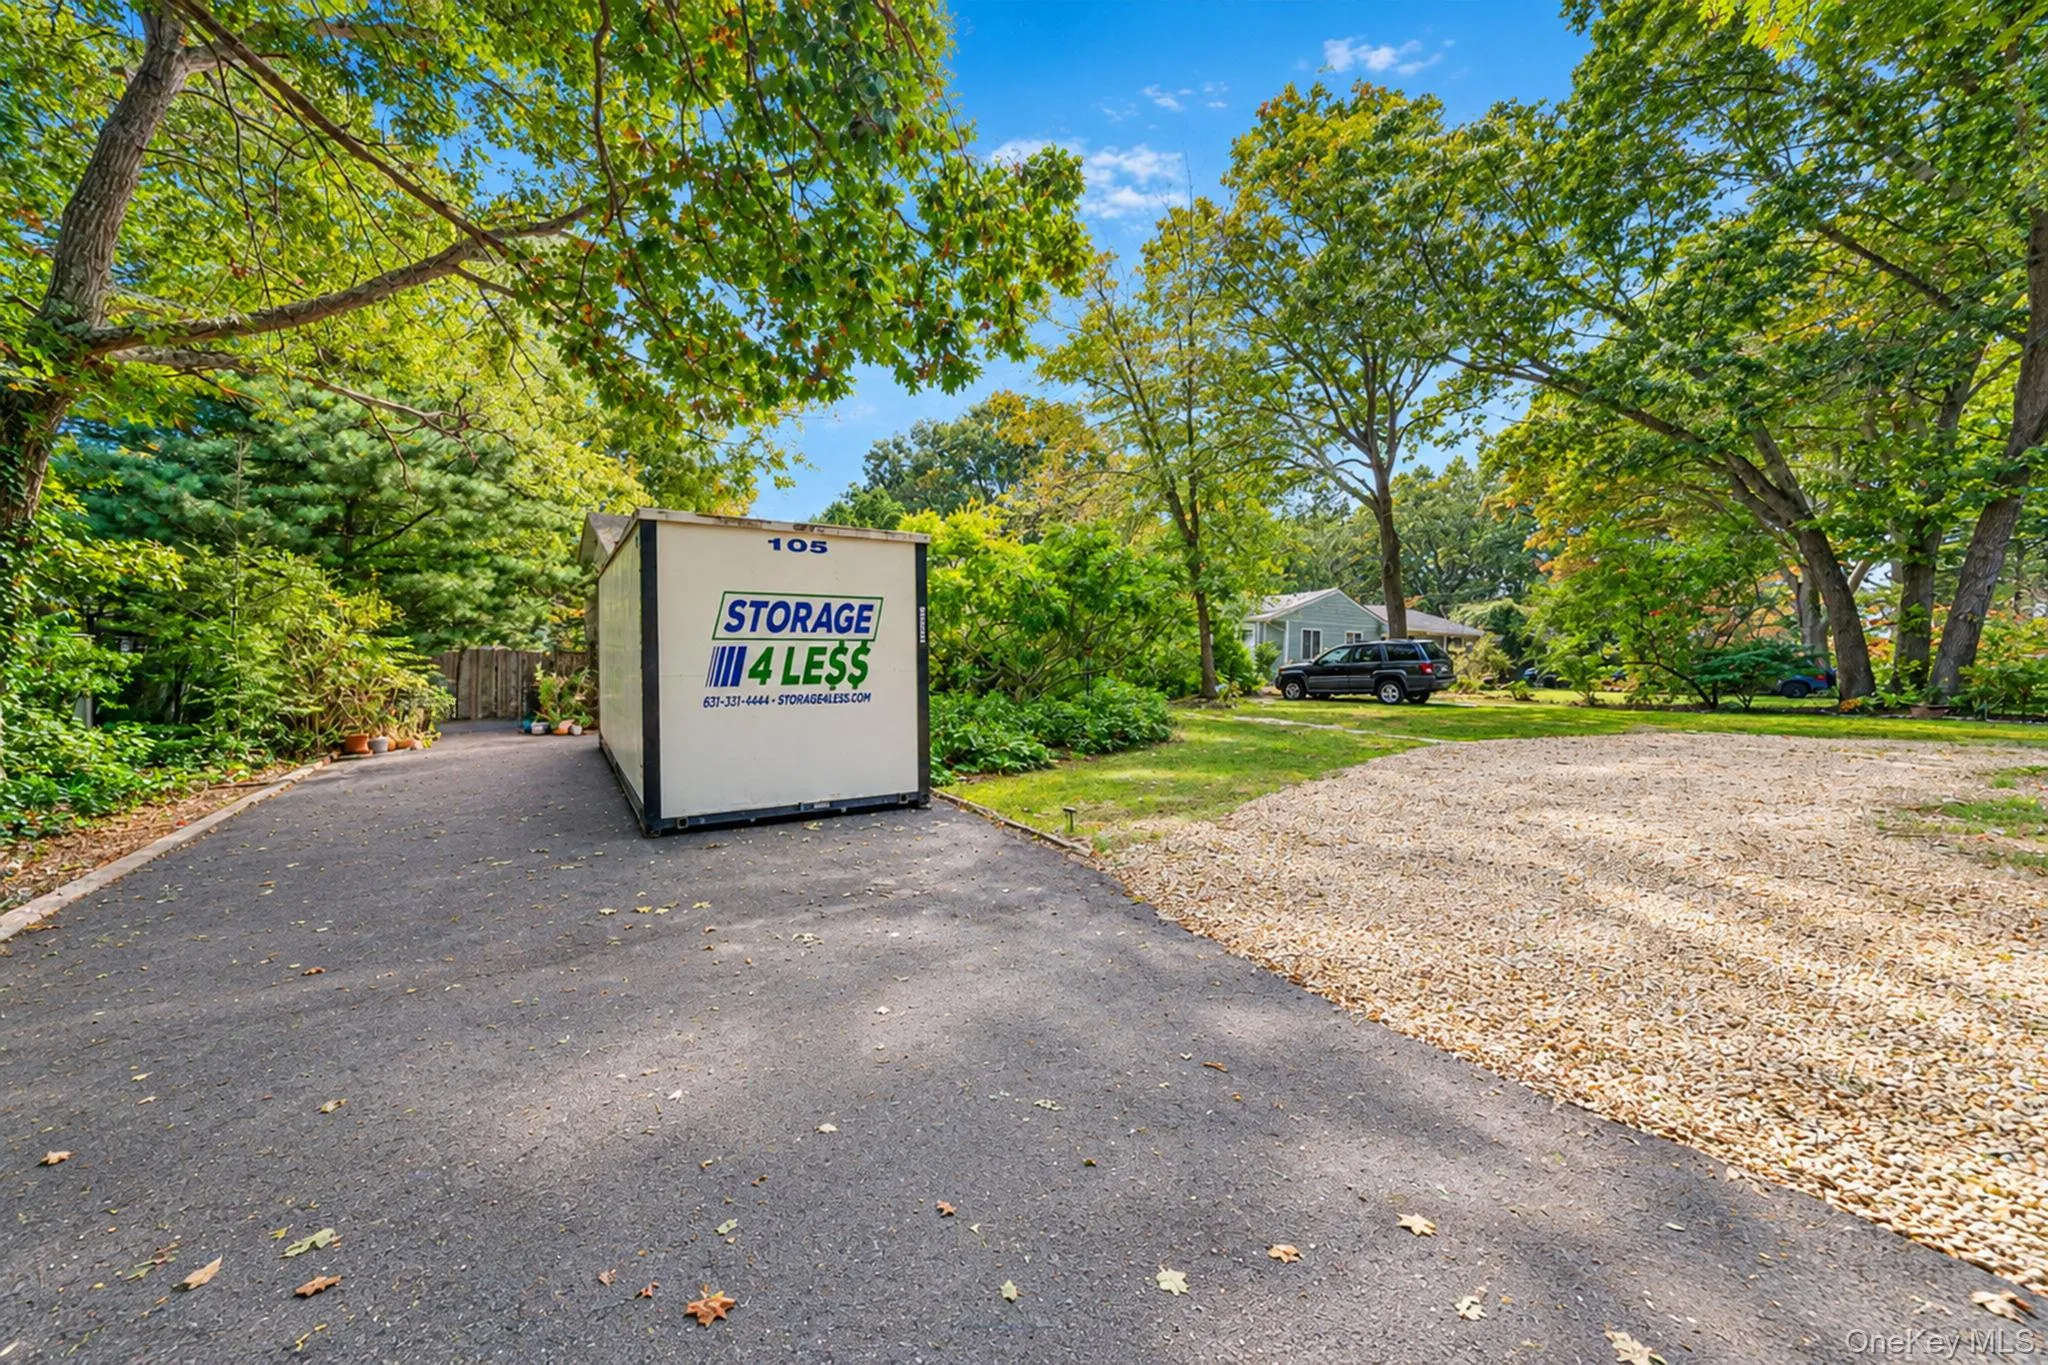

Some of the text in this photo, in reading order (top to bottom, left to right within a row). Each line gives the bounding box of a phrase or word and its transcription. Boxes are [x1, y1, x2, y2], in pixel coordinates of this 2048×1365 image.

[768, 538, 828, 554] 105
[723, 599, 874, 634] STORAGE
[748, 646, 775, 686] 4
[703, 692, 871, 708] 631-331-4444 STORAGE4LESS.COM
